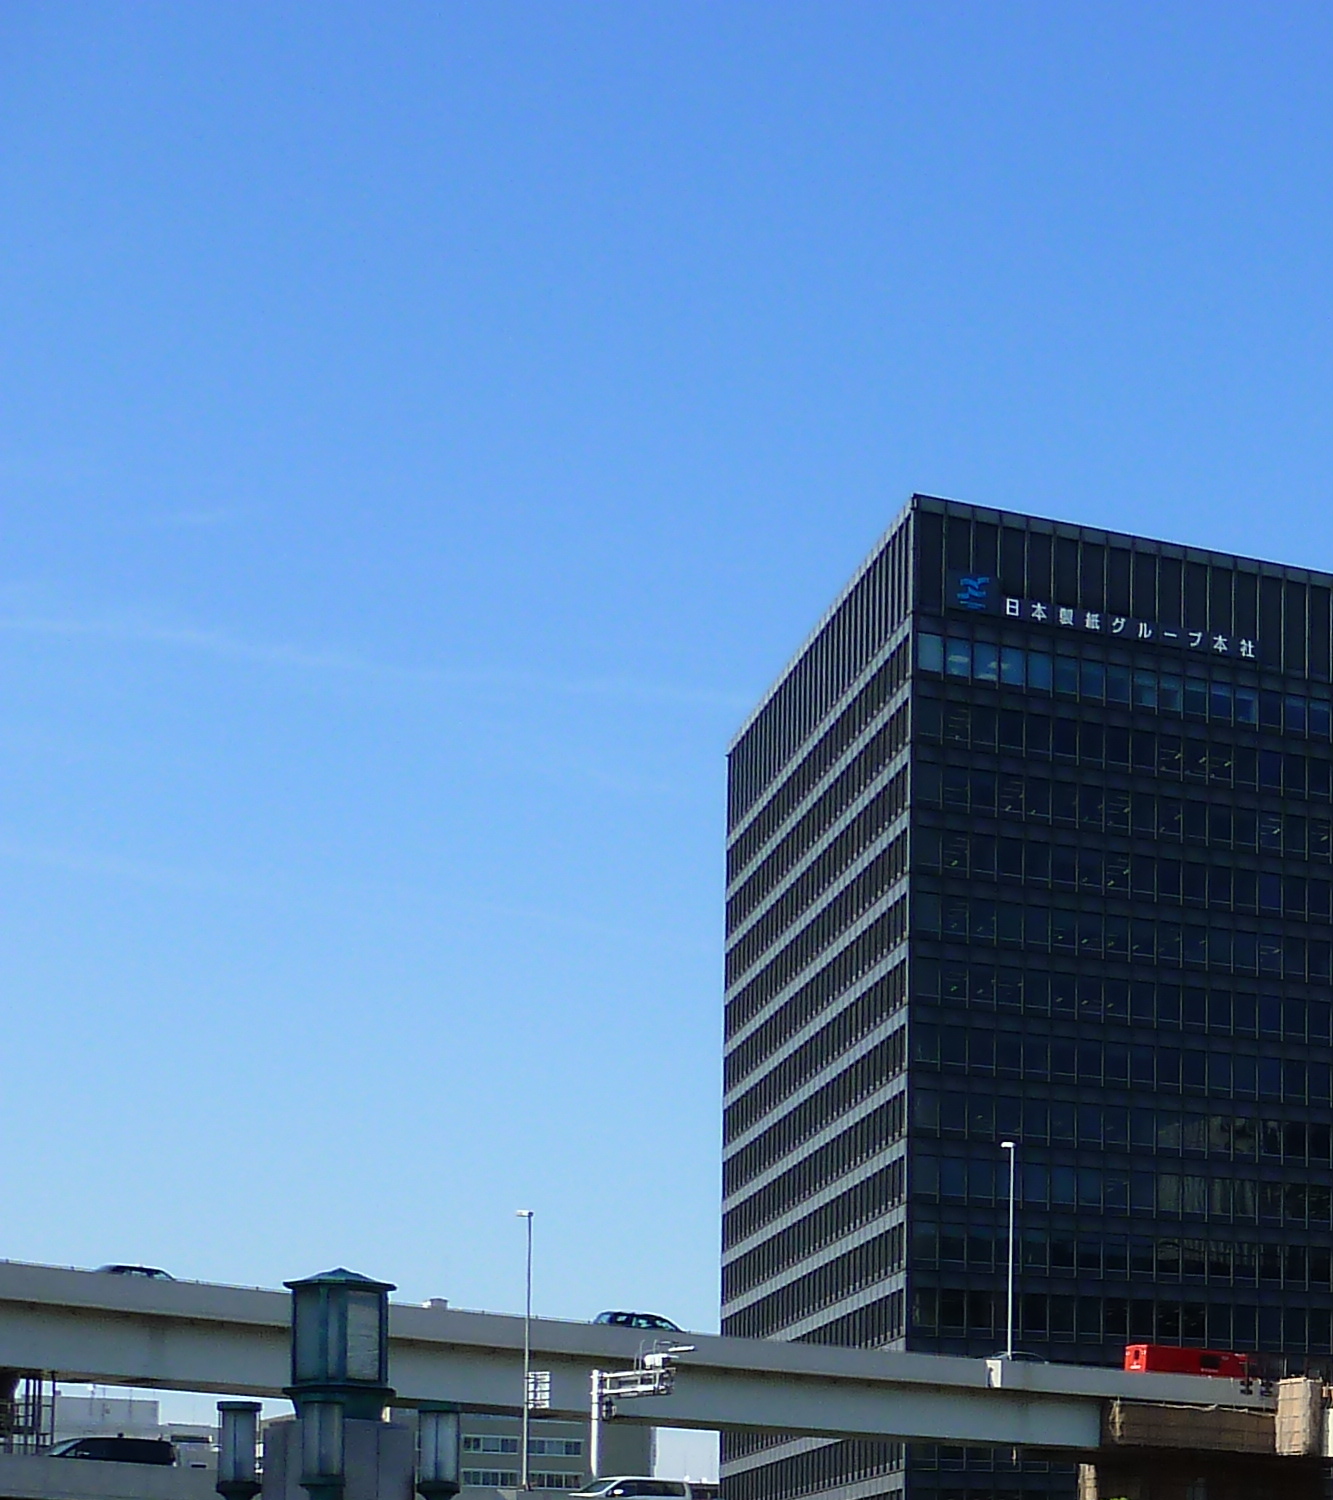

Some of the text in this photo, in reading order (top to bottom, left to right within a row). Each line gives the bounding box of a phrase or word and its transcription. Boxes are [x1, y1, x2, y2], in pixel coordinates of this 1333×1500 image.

[1005, 597, 1256, 658] 日本製紙グループ本社
